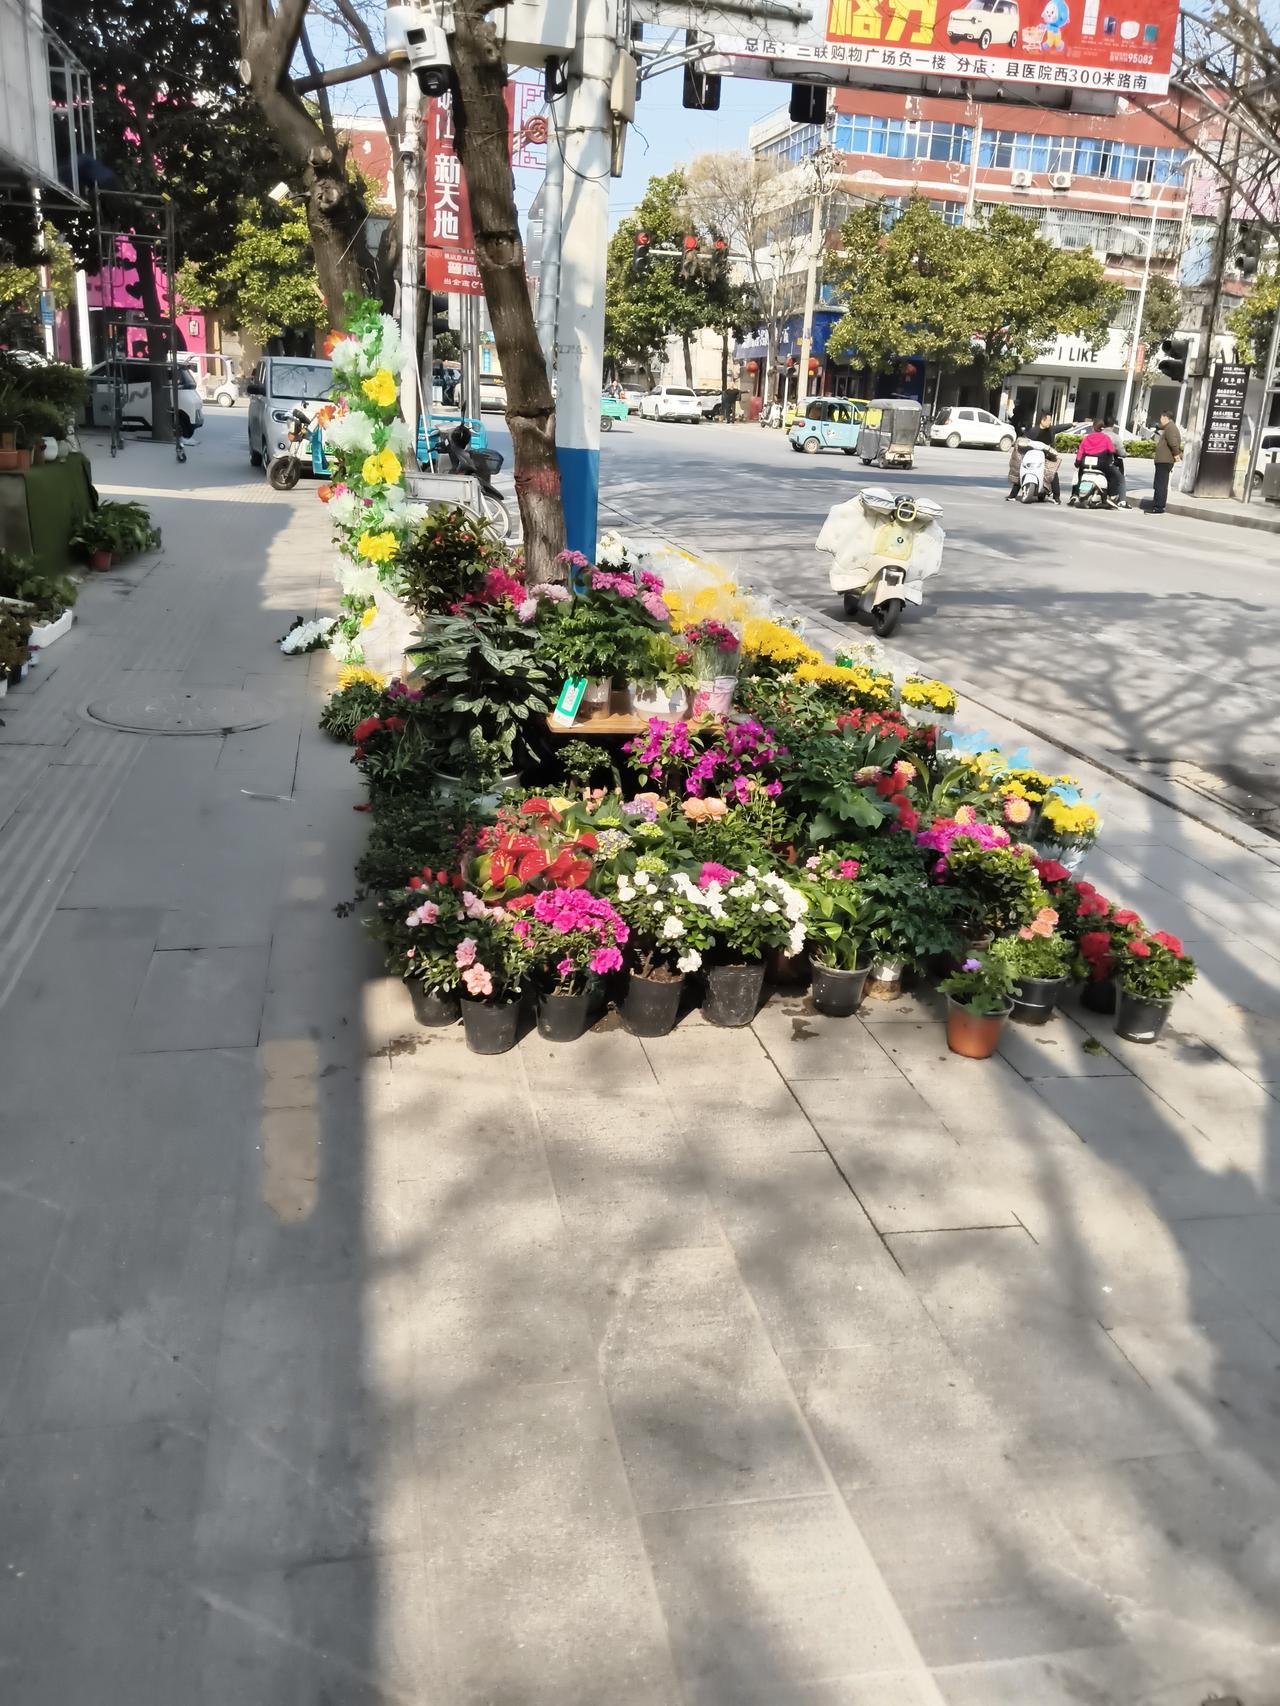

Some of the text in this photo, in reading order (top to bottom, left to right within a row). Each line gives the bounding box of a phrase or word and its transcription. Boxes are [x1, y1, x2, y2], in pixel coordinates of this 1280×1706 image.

[1128, 54, 1153, 65] 95082
[957, 57, 1148, 90] 分店：县医院西300米路南
[1068, 347, 1099, 363] LIKE
